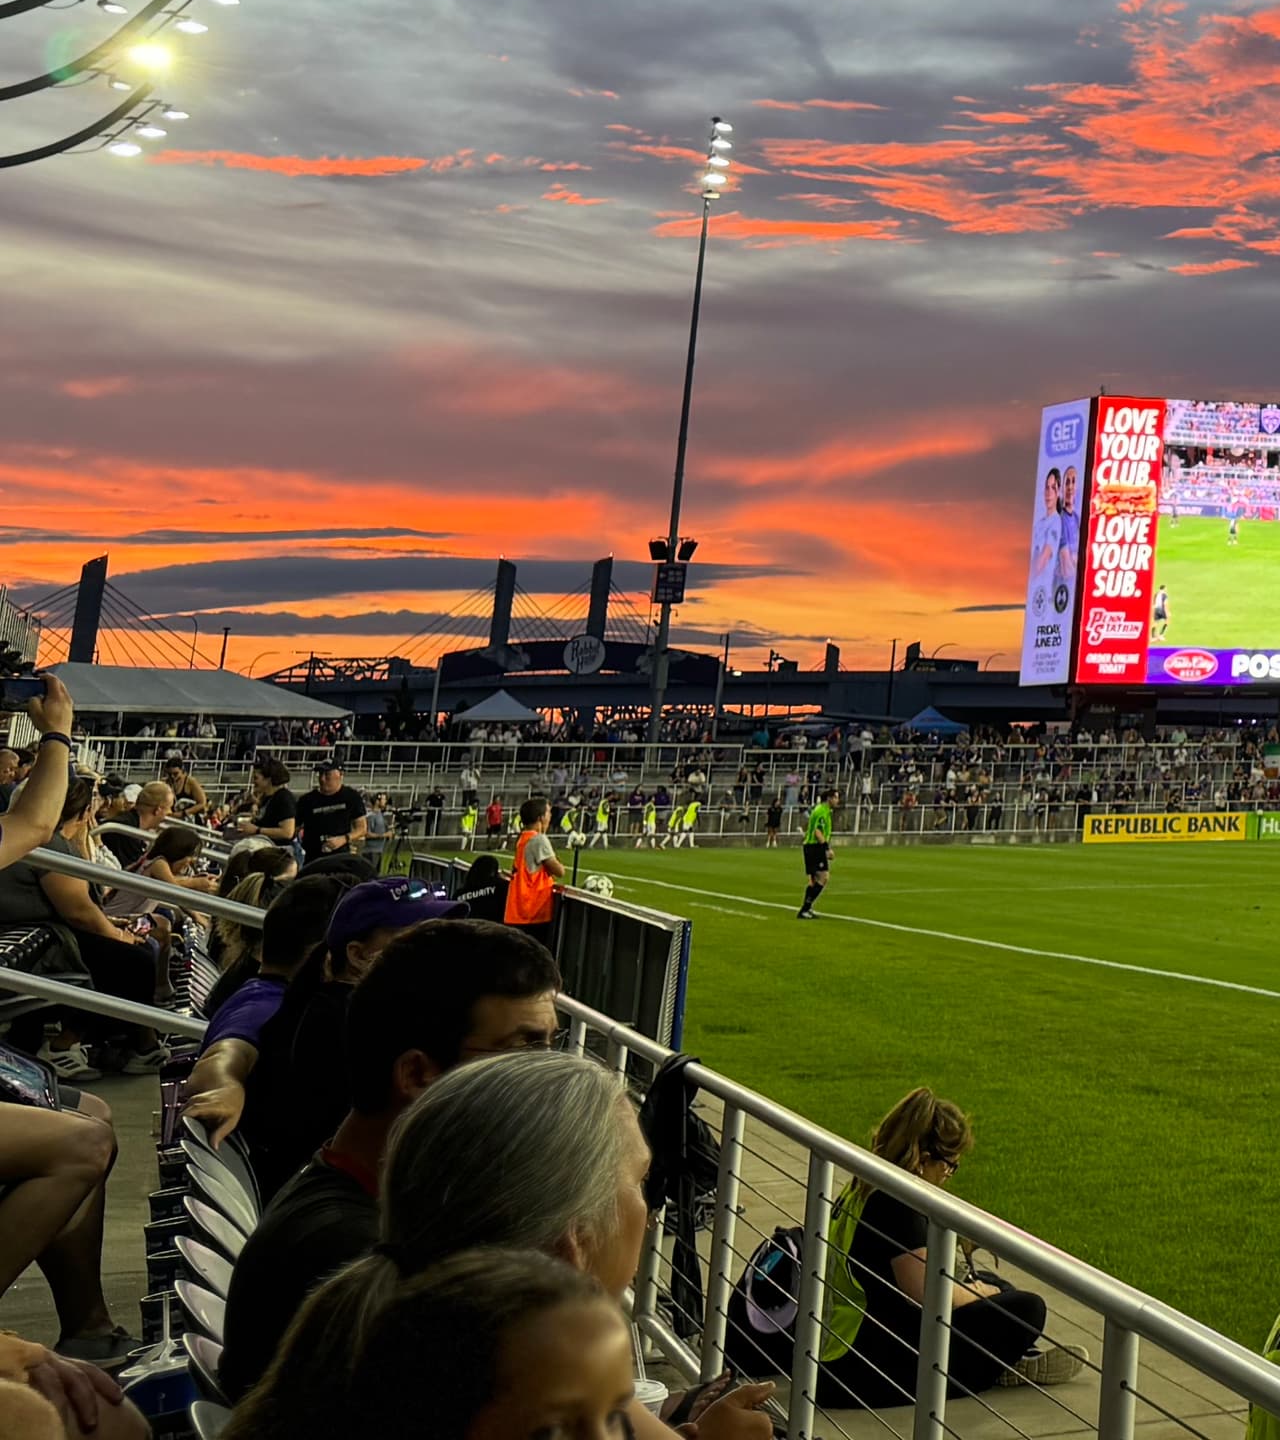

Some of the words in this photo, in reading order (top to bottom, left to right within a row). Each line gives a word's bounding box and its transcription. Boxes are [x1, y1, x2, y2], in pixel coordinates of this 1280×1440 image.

[1051, 419, 1079, 441] GET
[1104, 407, 1159, 434] LOVE
[1100, 433, 1160, 461] YOUR
[1096, 459, 1156, 489] CLUB.
[1095, 514, 1151, 543] LOVE
[1091, 543, 1152, 571] YOUR
[1092, 570, 1142, 598] SUB.
[1091, 816, 1181, 836] REPUBLIC
[1187, 815, 1240, 833] BANK
[457, 886, 496, 902] SECURITY
